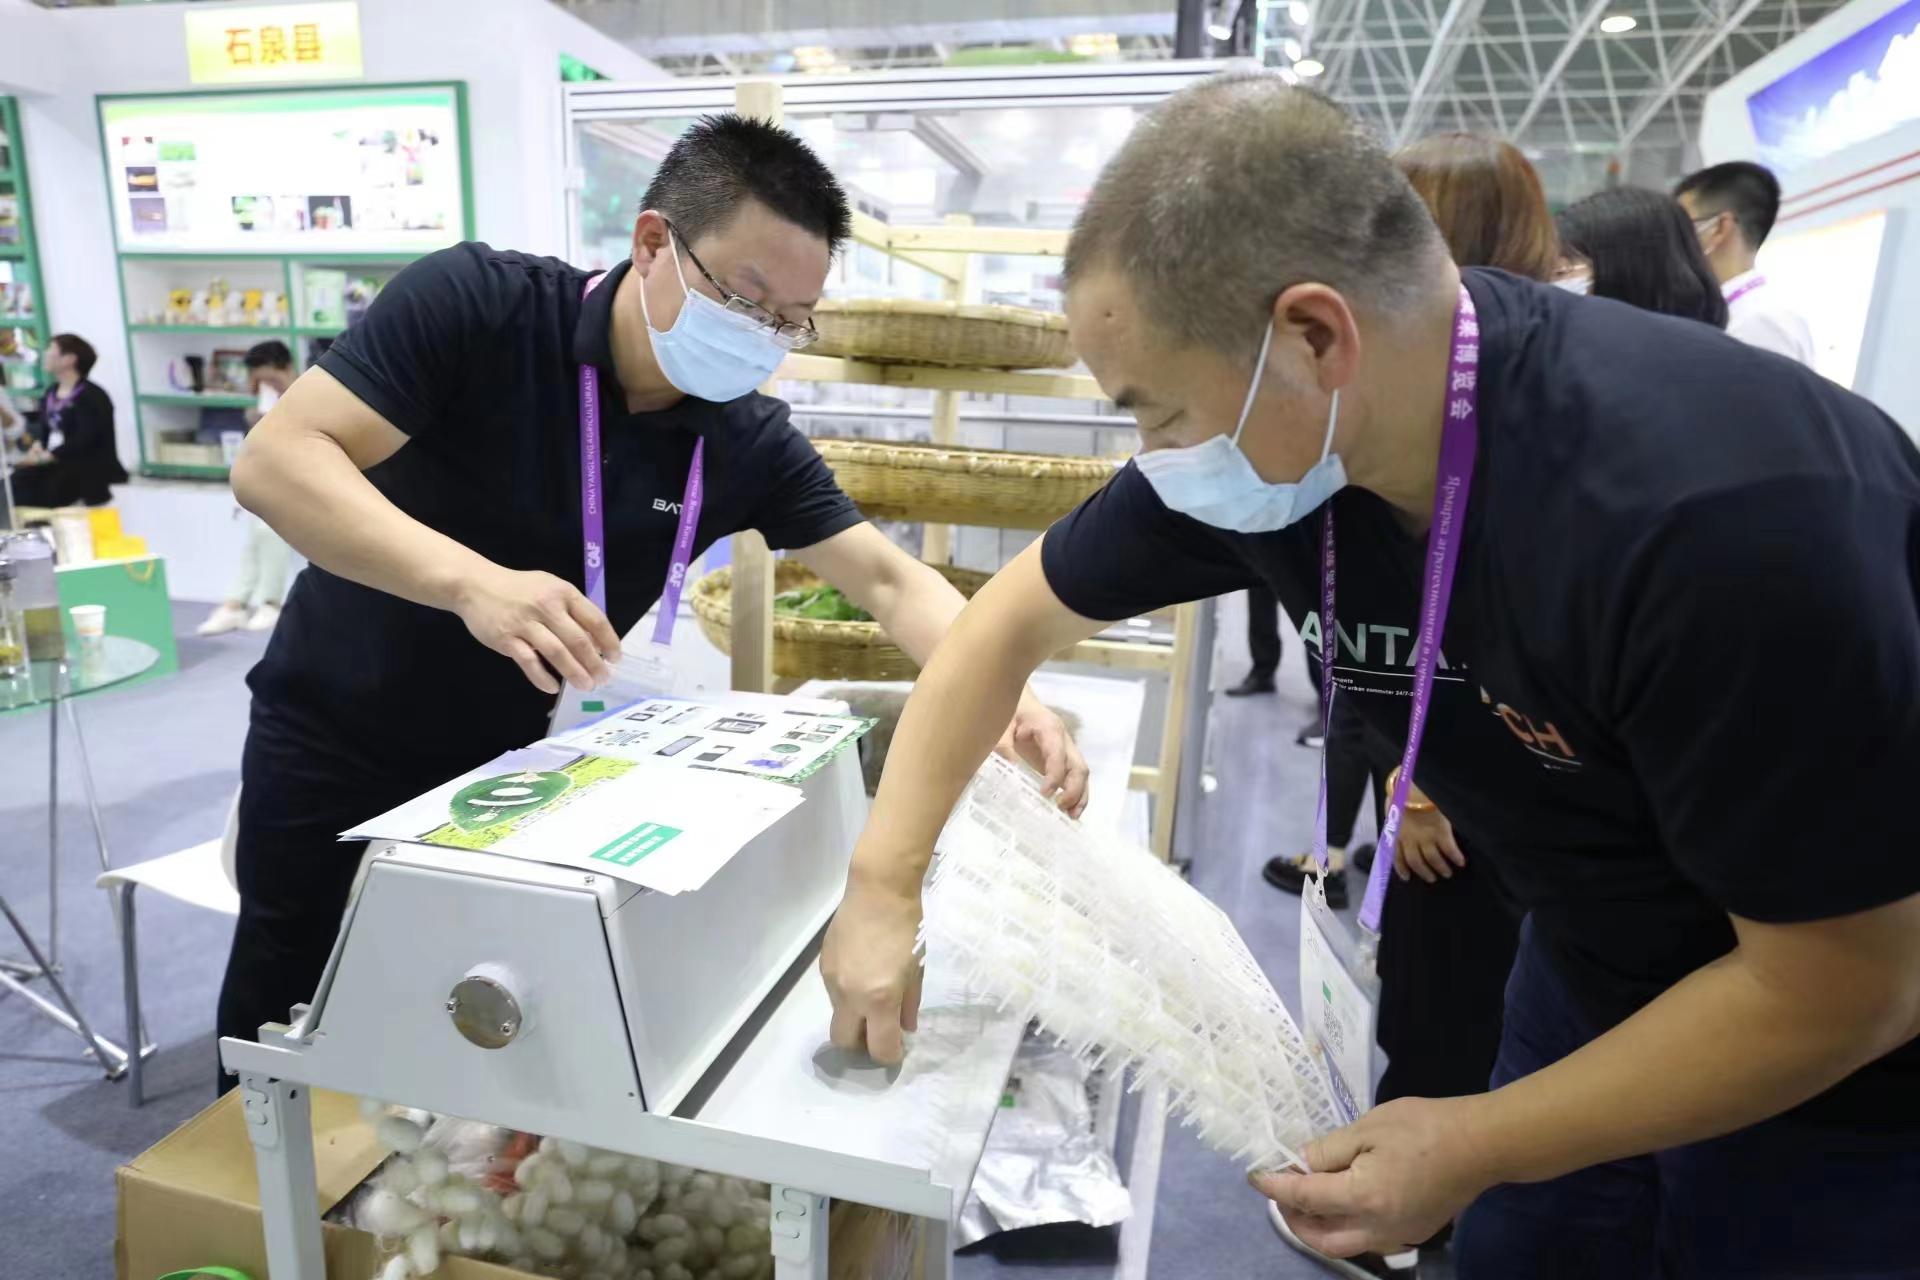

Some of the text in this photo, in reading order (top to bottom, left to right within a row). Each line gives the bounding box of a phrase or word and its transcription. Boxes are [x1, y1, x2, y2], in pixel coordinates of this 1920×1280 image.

[225, 23, 321, 65] 石泉县
[583, 380, 594, 444] AGRICULTURAL
[586, 445, 596, 489] YANGLING
[587, 489, 597, 514] CHINA
[1440, 475, 1461, 535] Ярмарка
[588, 542, 601, 568] CAF
[669, 562, 685, 587] CAF
